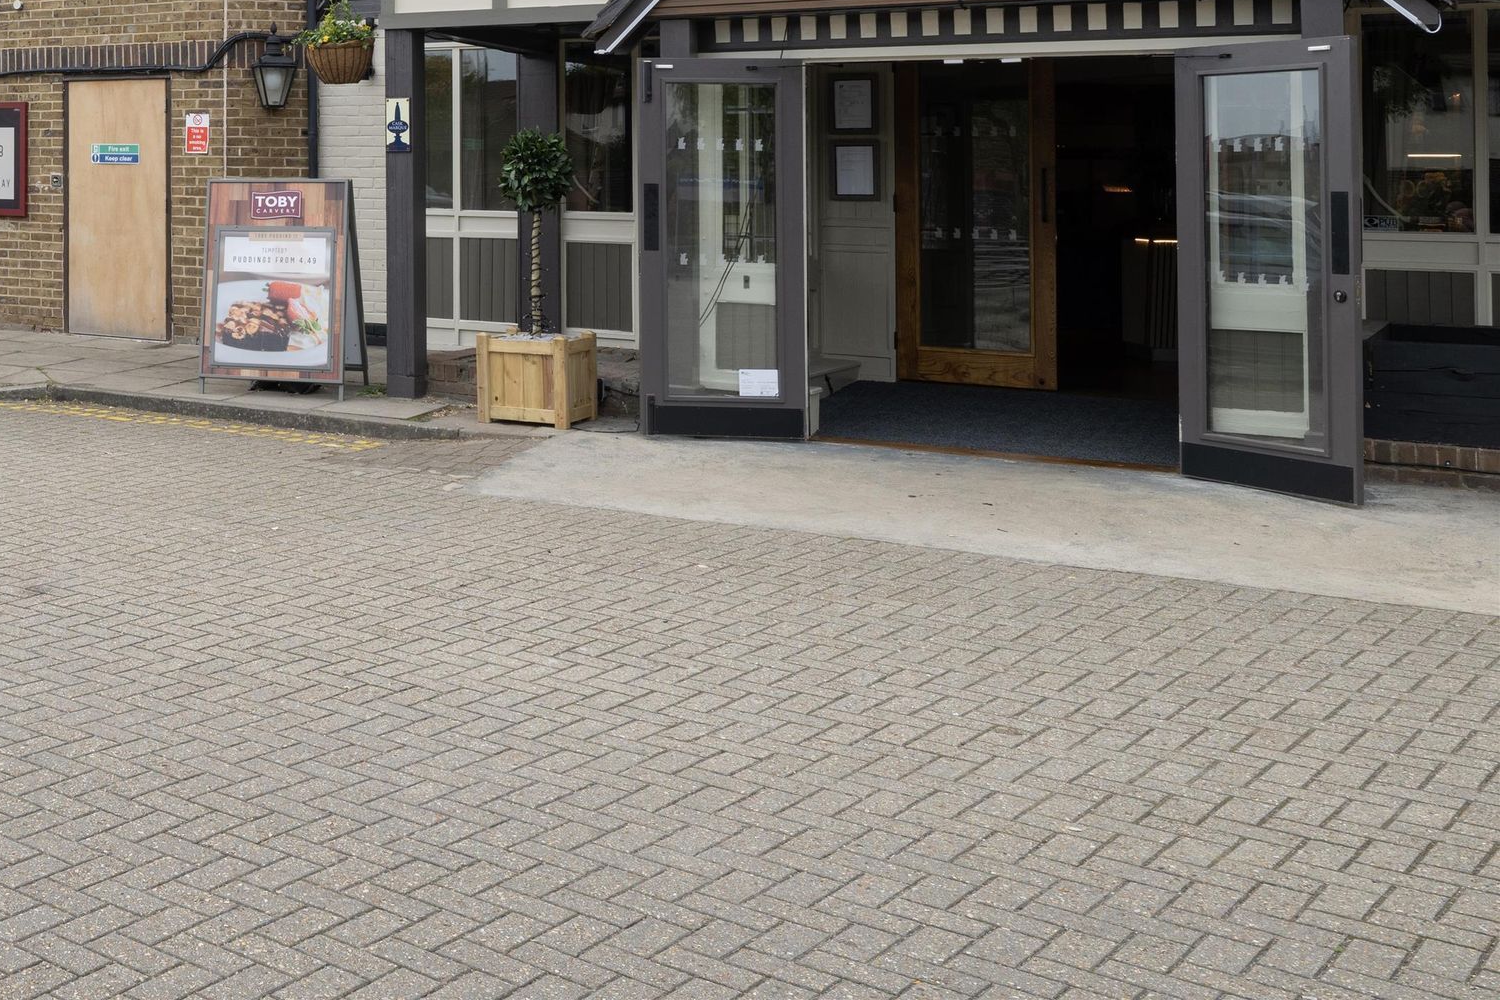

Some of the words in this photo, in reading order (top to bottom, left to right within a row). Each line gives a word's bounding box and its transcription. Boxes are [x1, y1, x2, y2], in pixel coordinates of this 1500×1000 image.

[254, 195, 298, 208] TOBY
[232, 255, 271, 264] PUDDINGS
[275, 256, 296, 264] FROM
[298, 256, 317, 265] 4.49
